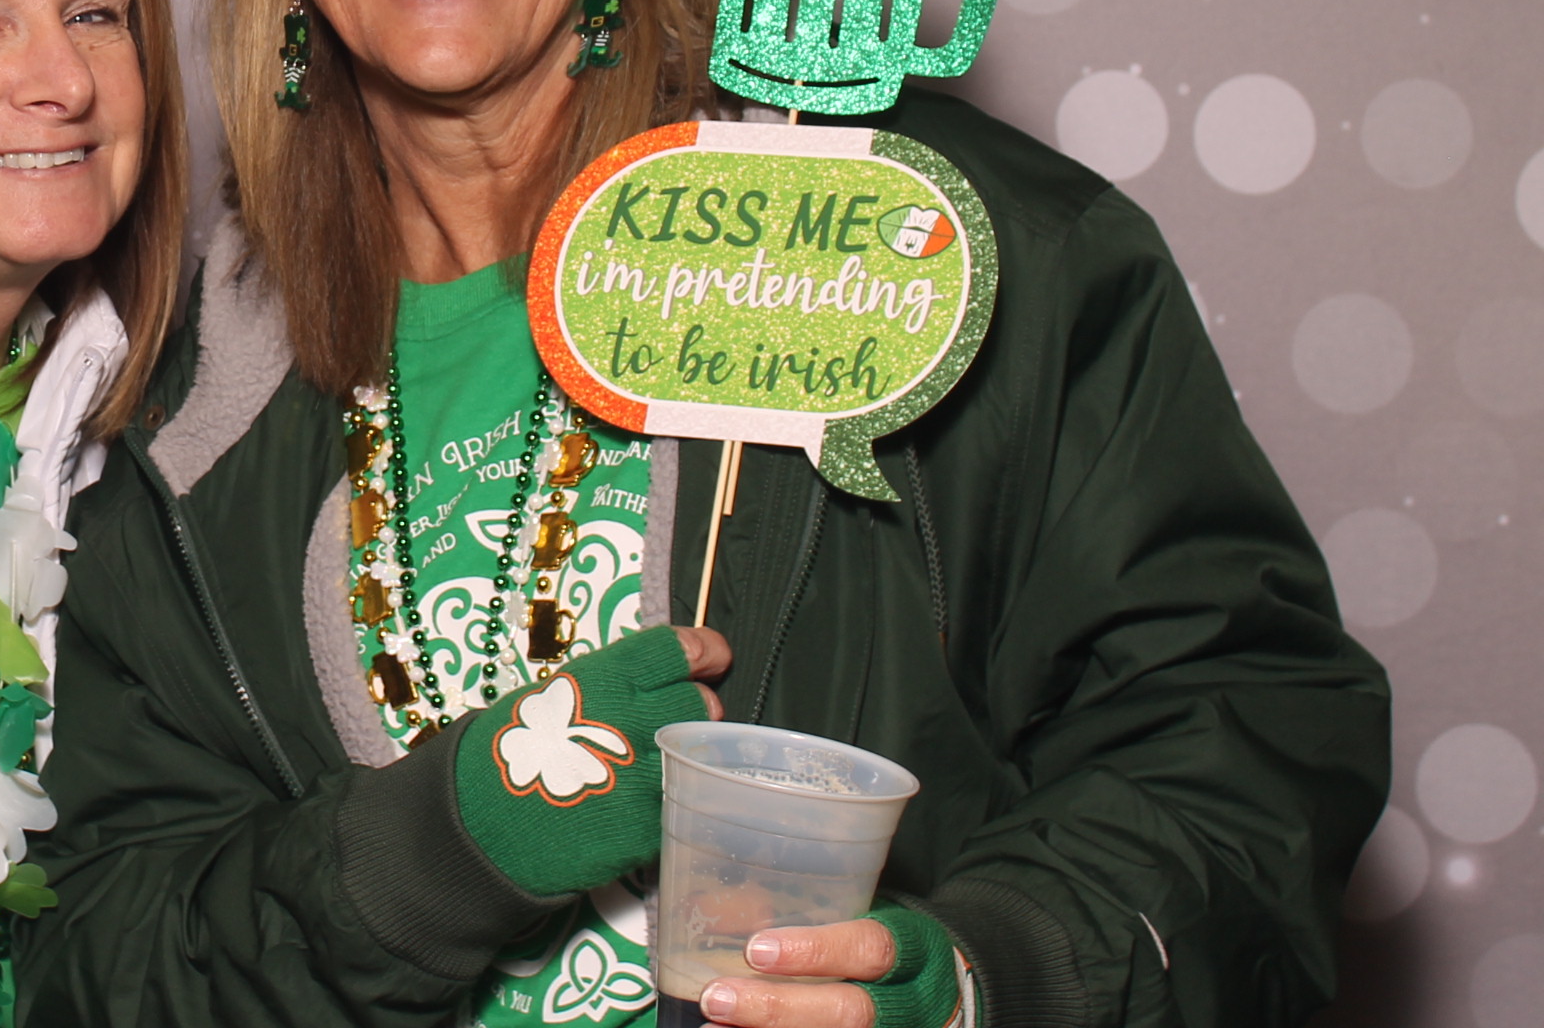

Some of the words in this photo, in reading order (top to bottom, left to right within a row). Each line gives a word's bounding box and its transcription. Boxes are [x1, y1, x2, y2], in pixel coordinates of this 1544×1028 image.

[606, 182, 768, 247] KISS
[784, 191, 880, 253] ME
[660, 248, 943, 334] pretending
[606, 317, 664, 377] to
[677, 324, 736, 385] be
[749, 336, 891, 400] irish
[441, 410, 522, 472] IRISH
